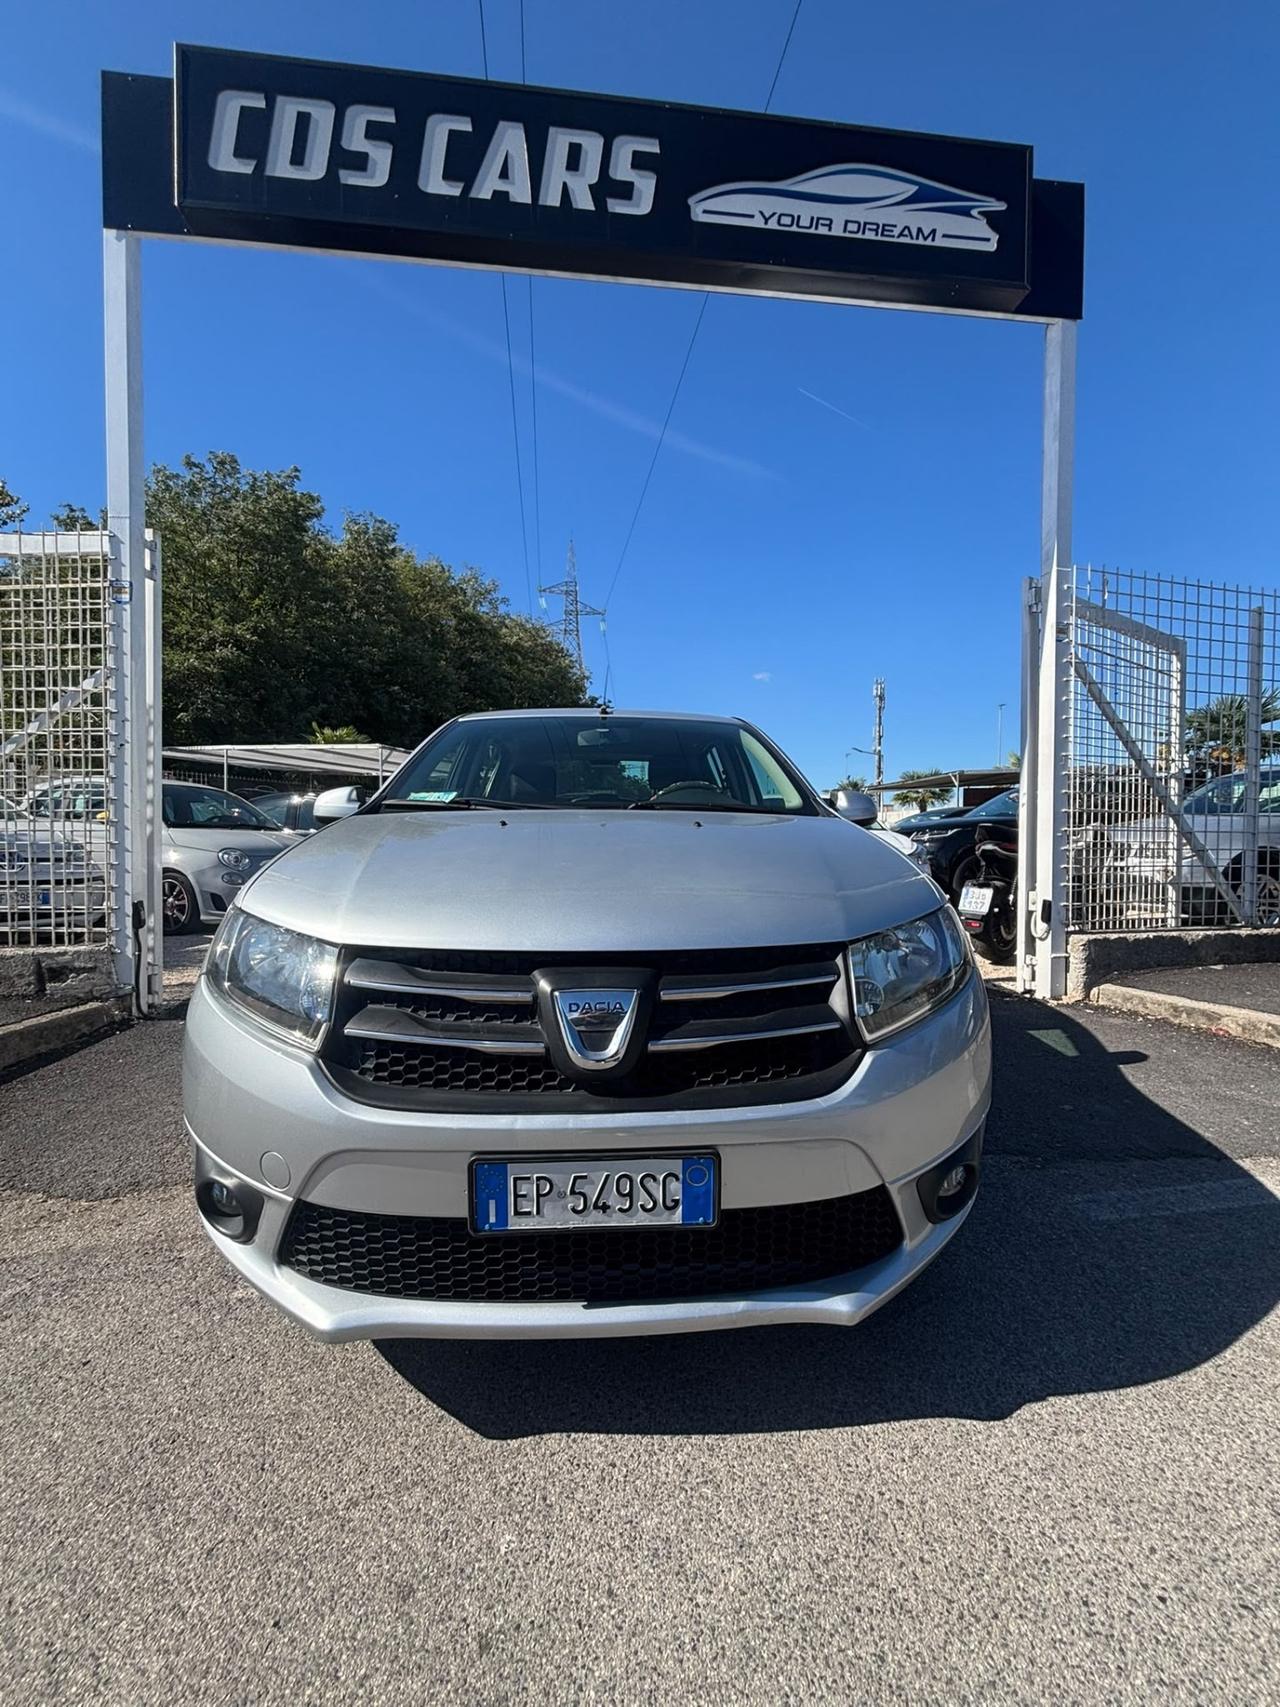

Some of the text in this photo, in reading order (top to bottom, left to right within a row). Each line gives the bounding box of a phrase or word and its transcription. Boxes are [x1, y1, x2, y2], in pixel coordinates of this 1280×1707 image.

[207, 88, 661, 216] CDS CARS
[758, 210, 938, 242] YOUR DREAM
[568, 1001, 625, 1014] DACIA
[511, 1171, 681, 1217] EP 549SG
